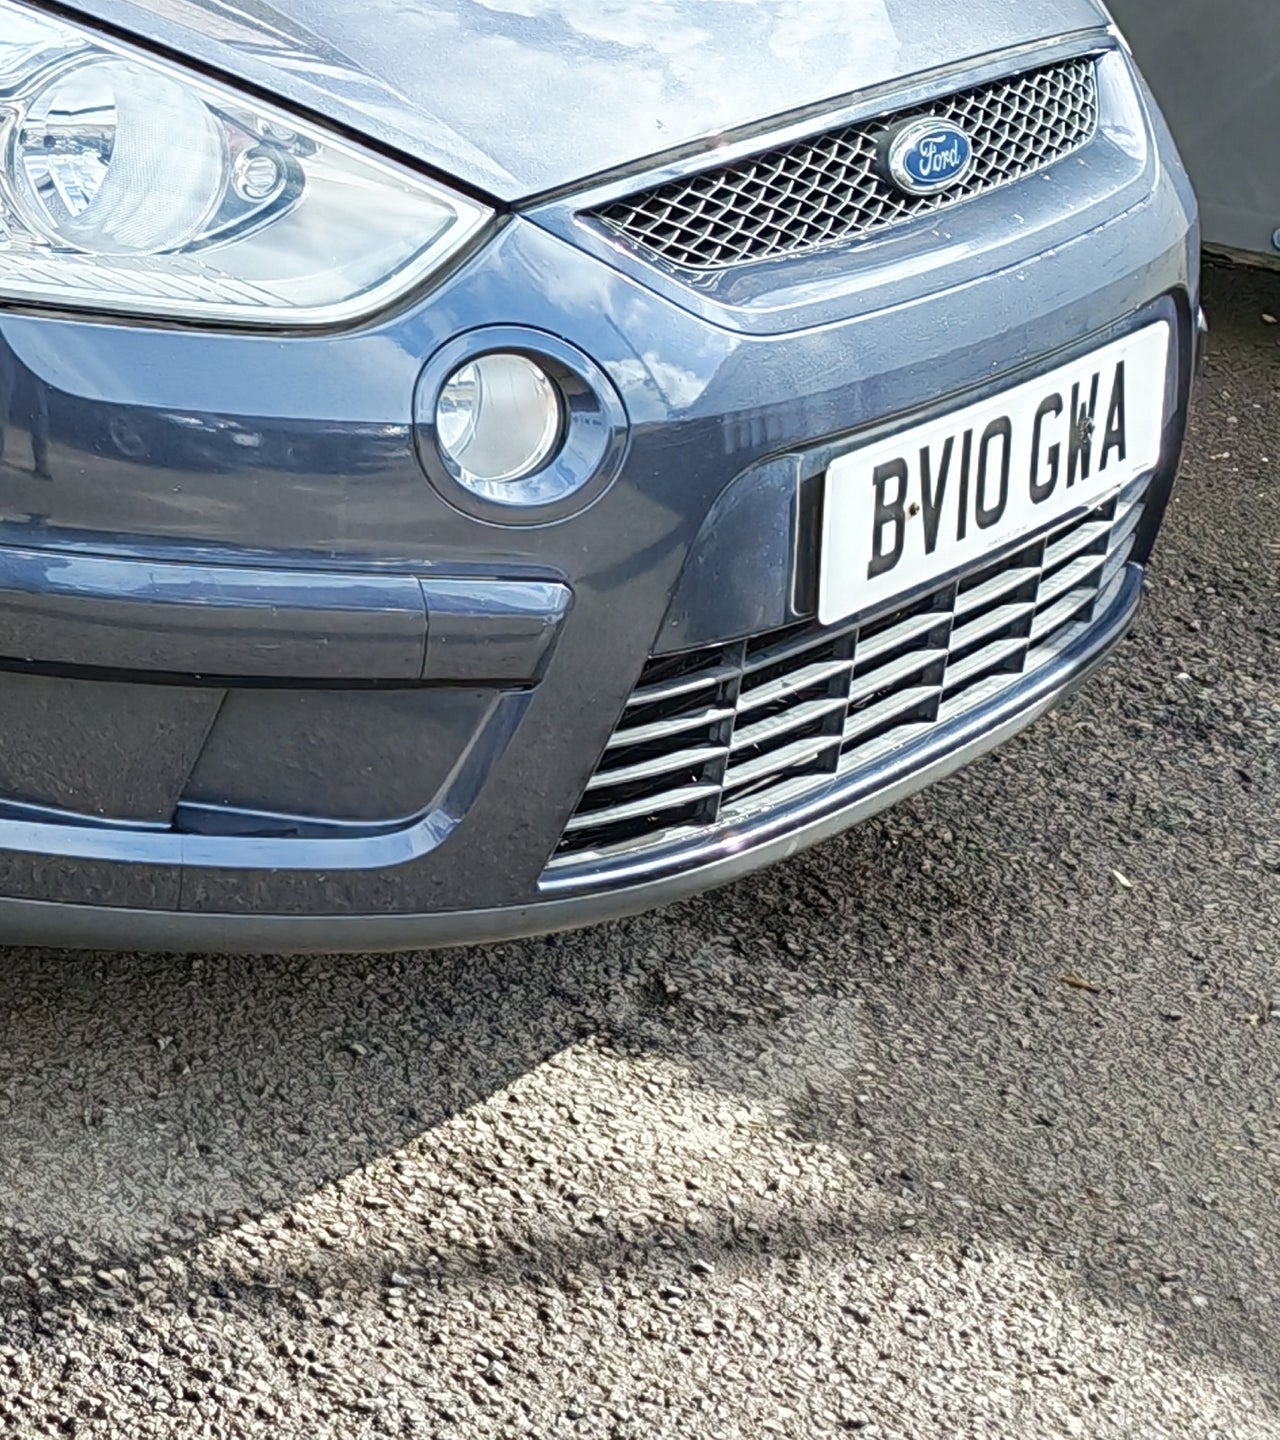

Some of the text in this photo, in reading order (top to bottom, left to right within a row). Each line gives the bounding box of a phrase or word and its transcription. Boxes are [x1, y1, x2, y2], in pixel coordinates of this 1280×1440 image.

[920, 135, 960, 176] Ford
[867, 360, 1126, 580] BV10 GWA
